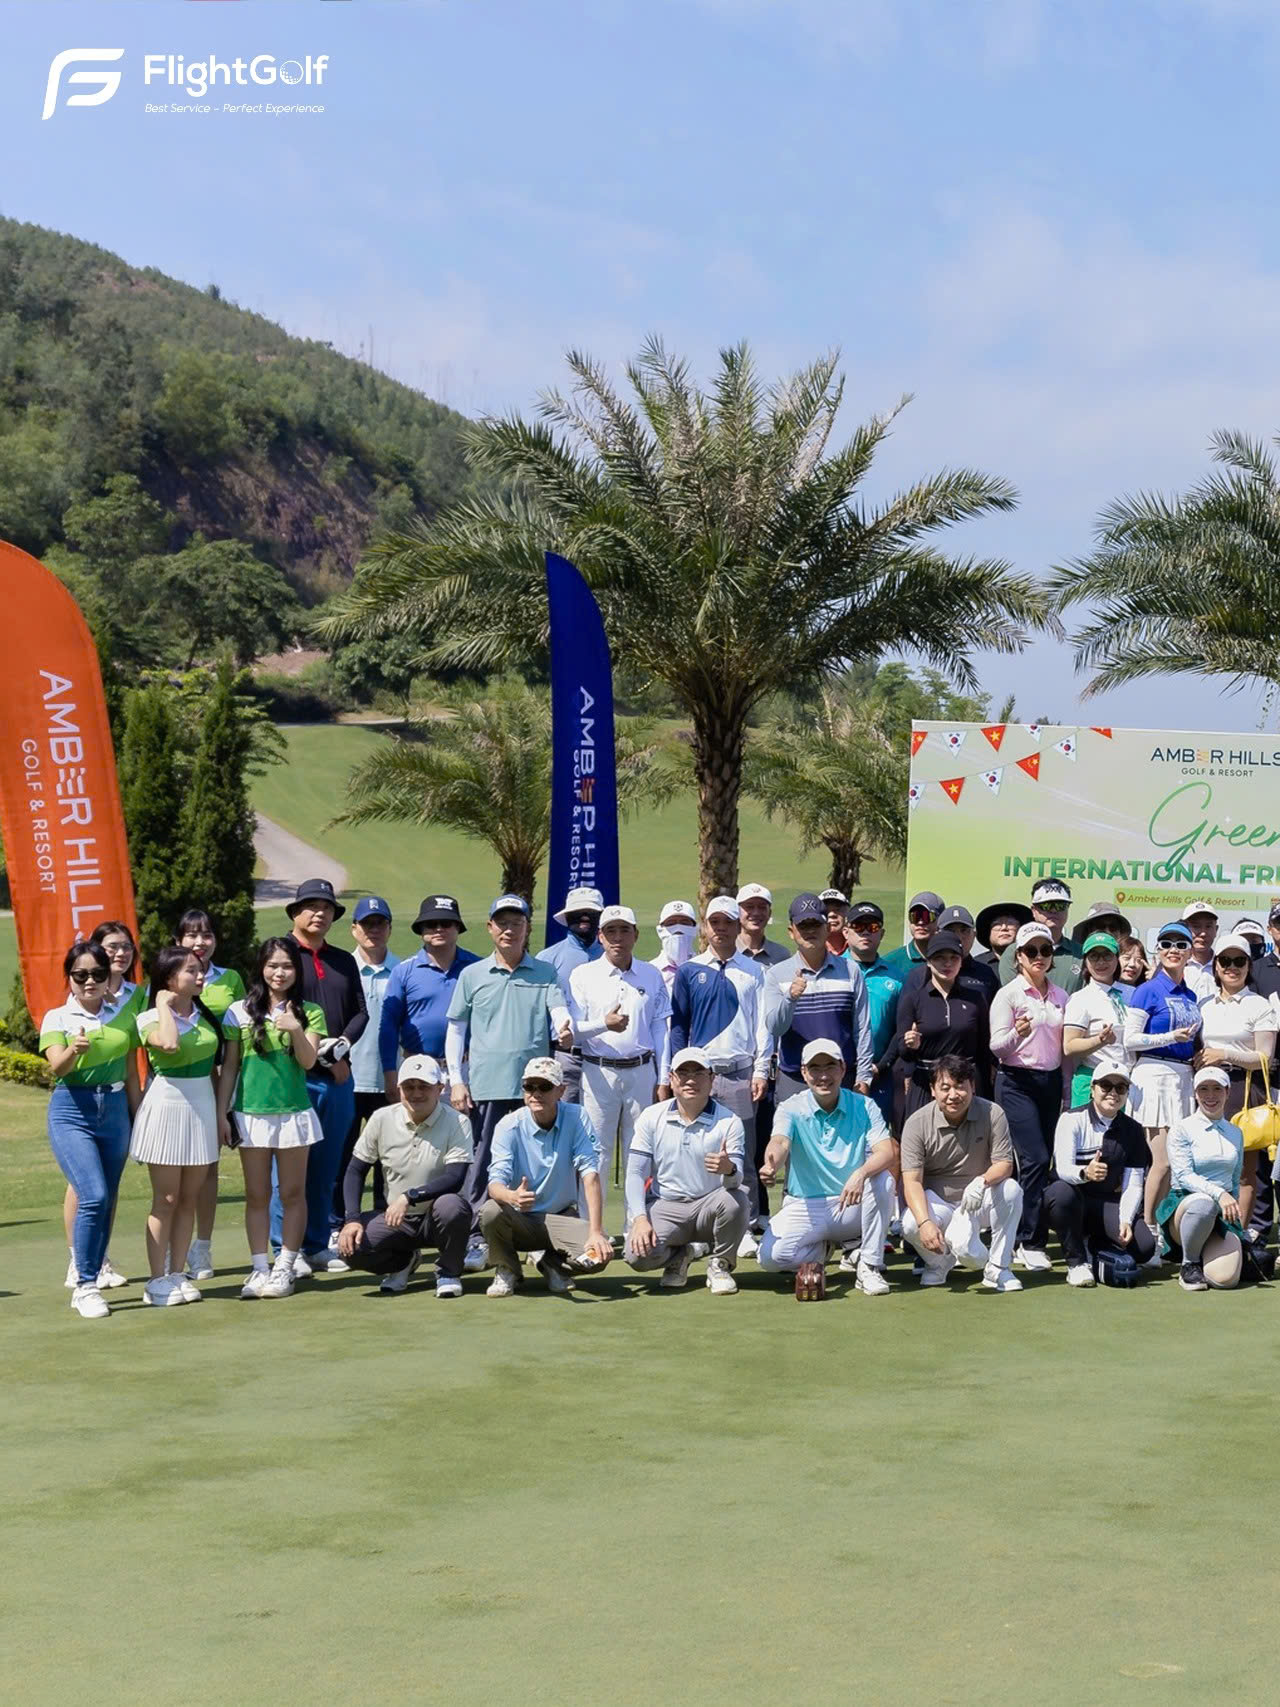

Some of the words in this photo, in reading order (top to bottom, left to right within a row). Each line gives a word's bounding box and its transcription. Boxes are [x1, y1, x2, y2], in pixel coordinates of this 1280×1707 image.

[39, 669, 93, 825] AMBER
[1150, 747, 1224, 764] AMBER
[21, 738, 43, 792] GOLF
[1181, 767, 1206, 776] GOLF
[1209, 768, 1216, 776] &
[1218, 768, 1254, 778] RESORT
[29, 799, 45, 812] &
[31, 818, 57, 894] RESORT
[1003, 855, 1232, 885] INTERNATIONAL
[1127, 894, 1160, 904] Amber
[1162, 895, 1181, 905] Hills
[1214, 897, 1246, 907] Resort
